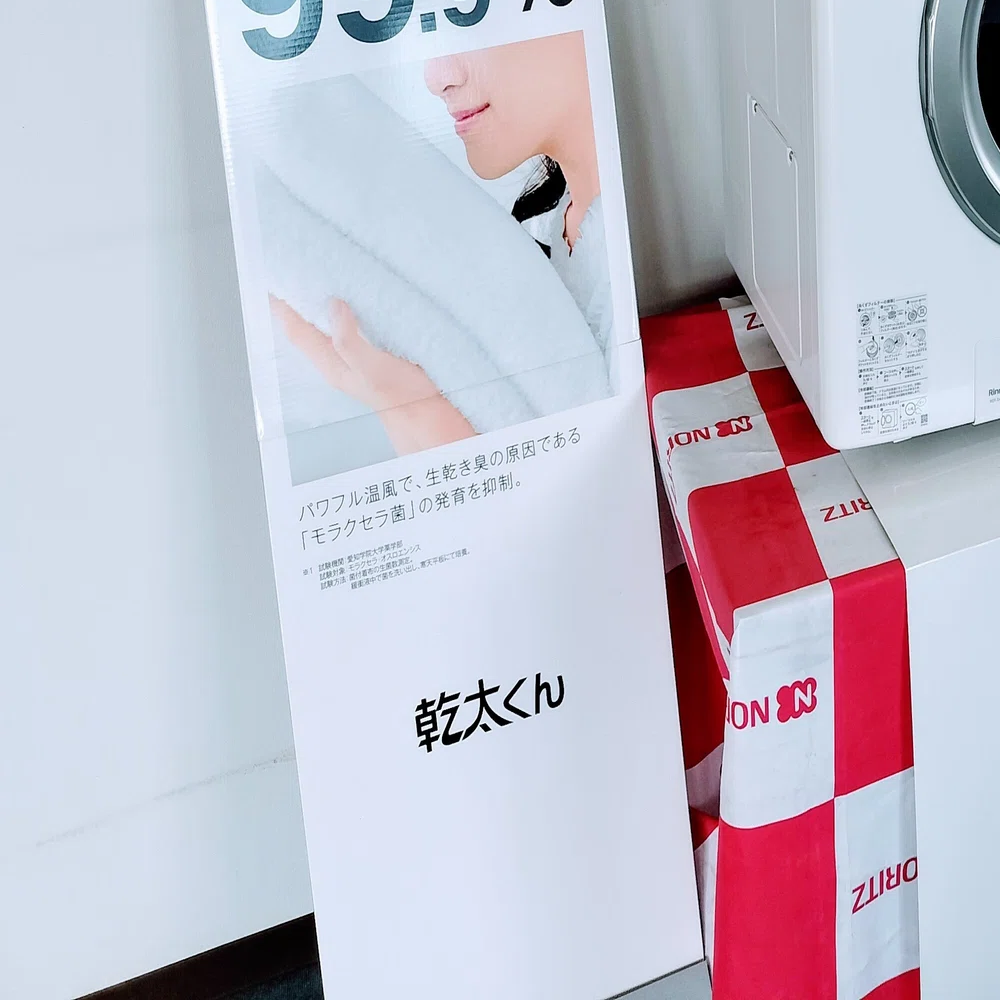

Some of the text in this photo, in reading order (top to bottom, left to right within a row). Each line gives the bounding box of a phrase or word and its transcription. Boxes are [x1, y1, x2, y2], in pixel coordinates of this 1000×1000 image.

[299, 427, 582, 522] パワフル温風で、生乾き臭の原因である
[300, 472, 521, 551] 「モラクセラ菌」の発育を抑制。
[820, 497, 873, 522] RITZ
[415, 672, 565, 753] 乾太くん
[852, 857, 918, 915] ORITZ
